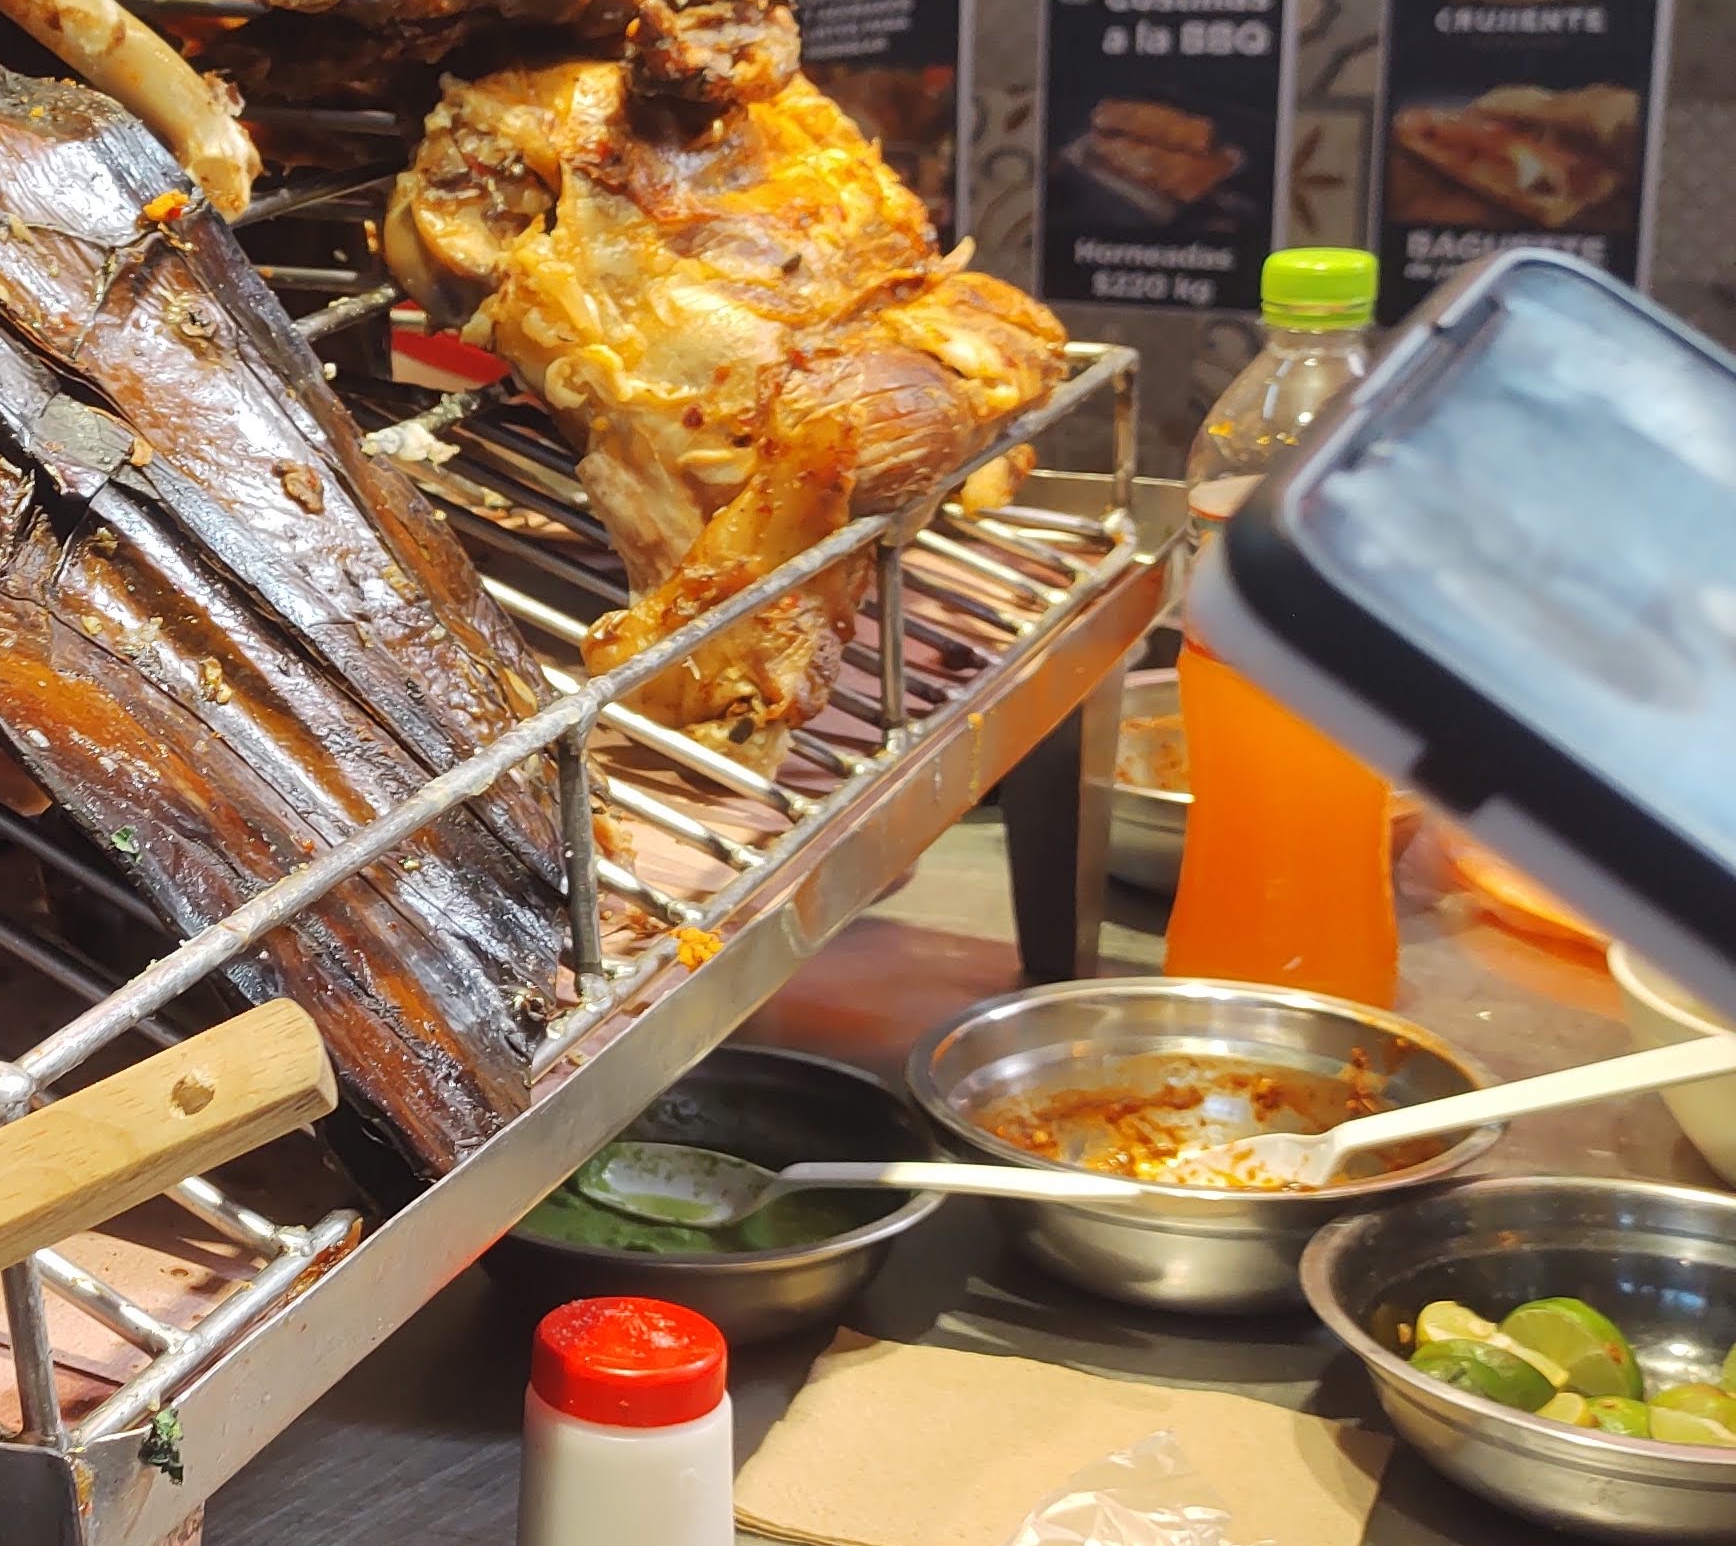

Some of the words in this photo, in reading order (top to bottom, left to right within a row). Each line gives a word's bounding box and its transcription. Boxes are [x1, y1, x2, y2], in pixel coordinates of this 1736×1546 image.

[1101, 23, 1130, 56] a
[1135, 16, 1173, 56] la
[1179, 16, 1272, 57] BBQ
[1072, 236, 1235, 272] Horneadas
[1173, 271, 1217, 306] kg
